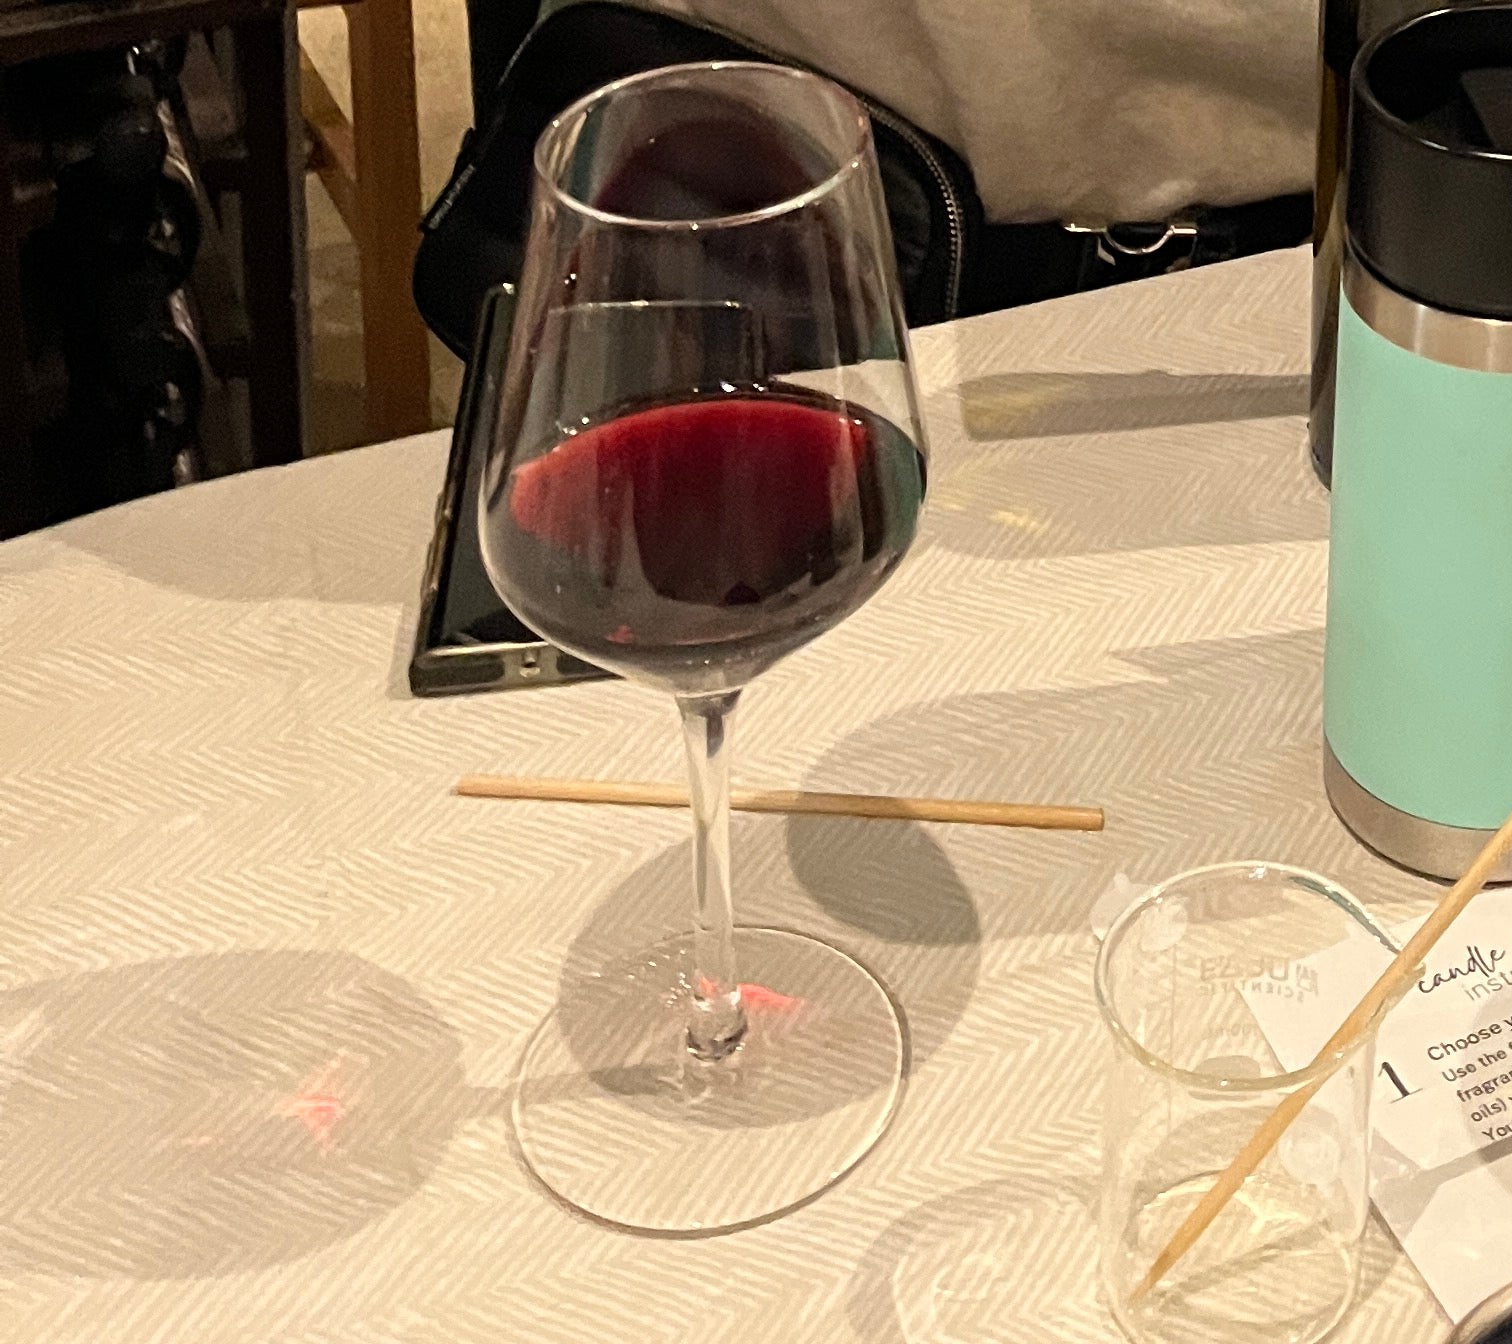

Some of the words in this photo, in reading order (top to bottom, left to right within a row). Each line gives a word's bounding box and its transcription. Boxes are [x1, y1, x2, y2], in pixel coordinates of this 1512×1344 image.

[1418, 945, 1506, 993] candle
[1427, 1018, 1503, 1062] Choose
[1377, 1061, 1423, 1104] 1
[1441, 1062, 1478, 1082] Use
[1483, 1047, 1507, 1068] the
[1470, 1099, 1508, 1123] oils)
